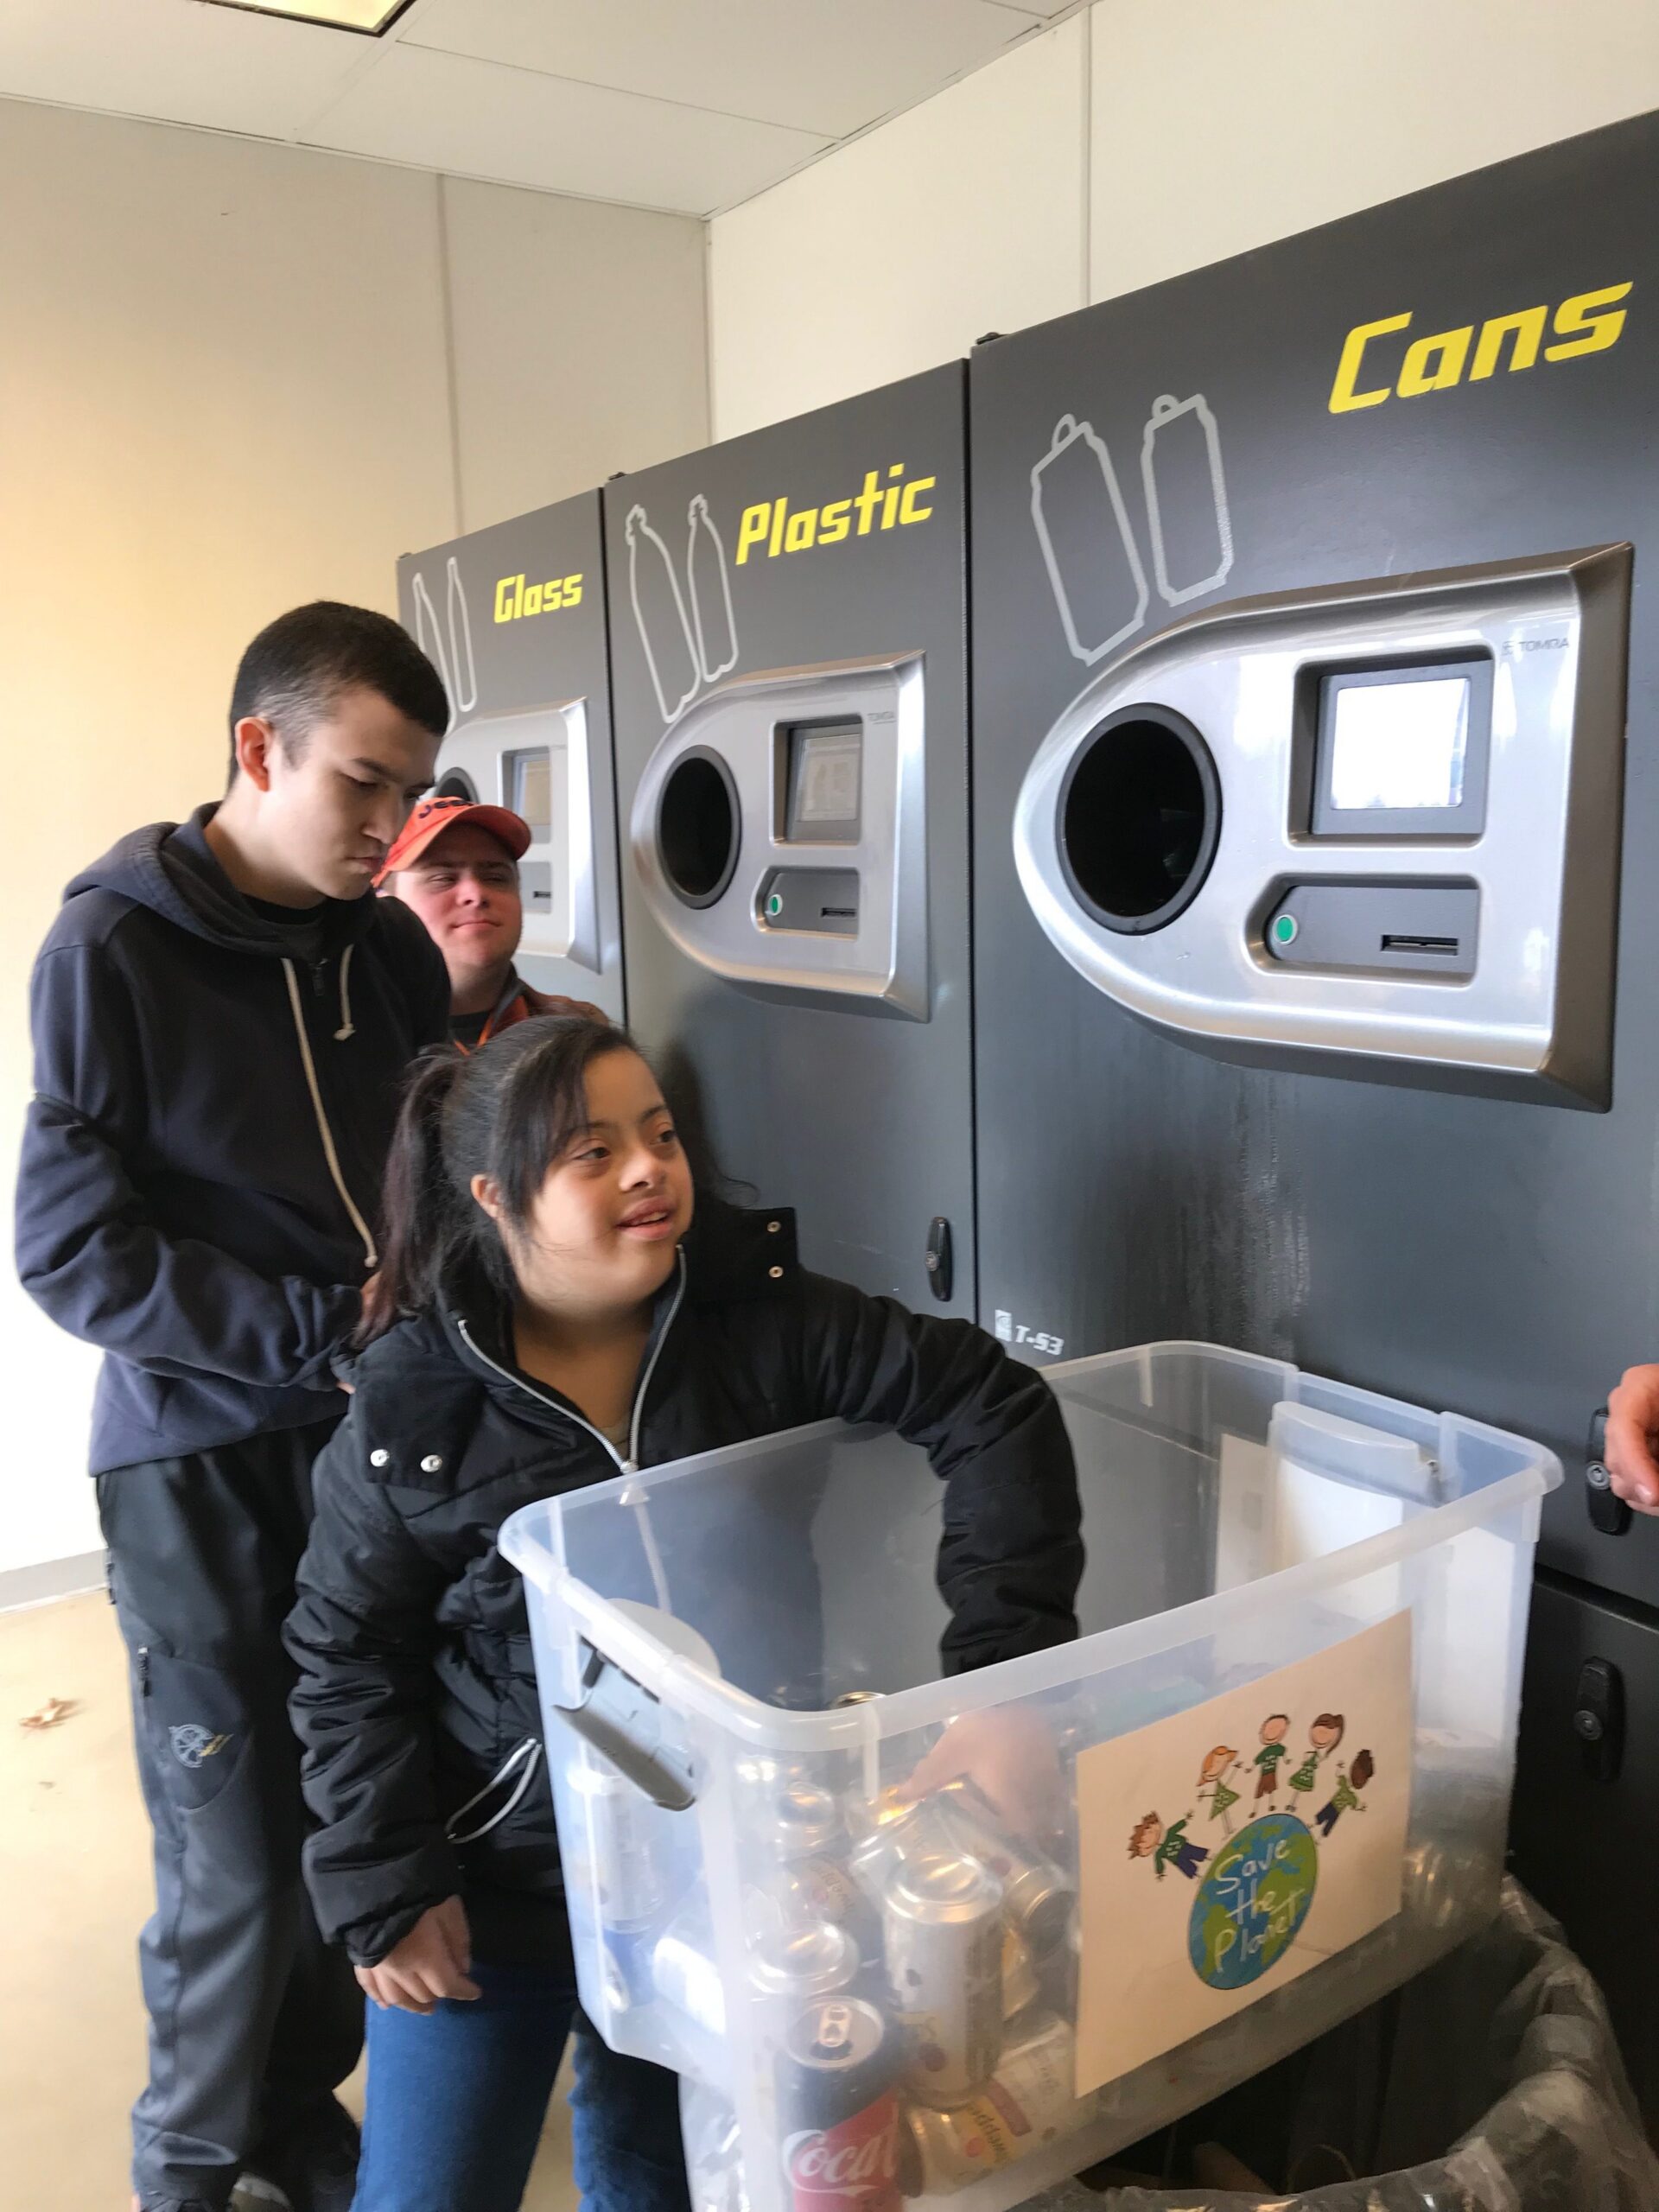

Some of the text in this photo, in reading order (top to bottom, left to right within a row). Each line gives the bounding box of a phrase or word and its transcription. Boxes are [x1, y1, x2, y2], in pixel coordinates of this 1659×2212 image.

[1328, 281, 1633, 414] Cans
[735, 462, 937, 565] Plastic
[493, 573, 583, 624] Glass
[1518, 638, 1570, 652] TOMRA
[1215, 1839, 1290, 1895] Save
[1224, 1878, 1277, 1925] the
[1214, 1888, 1306, 1973] Planet
